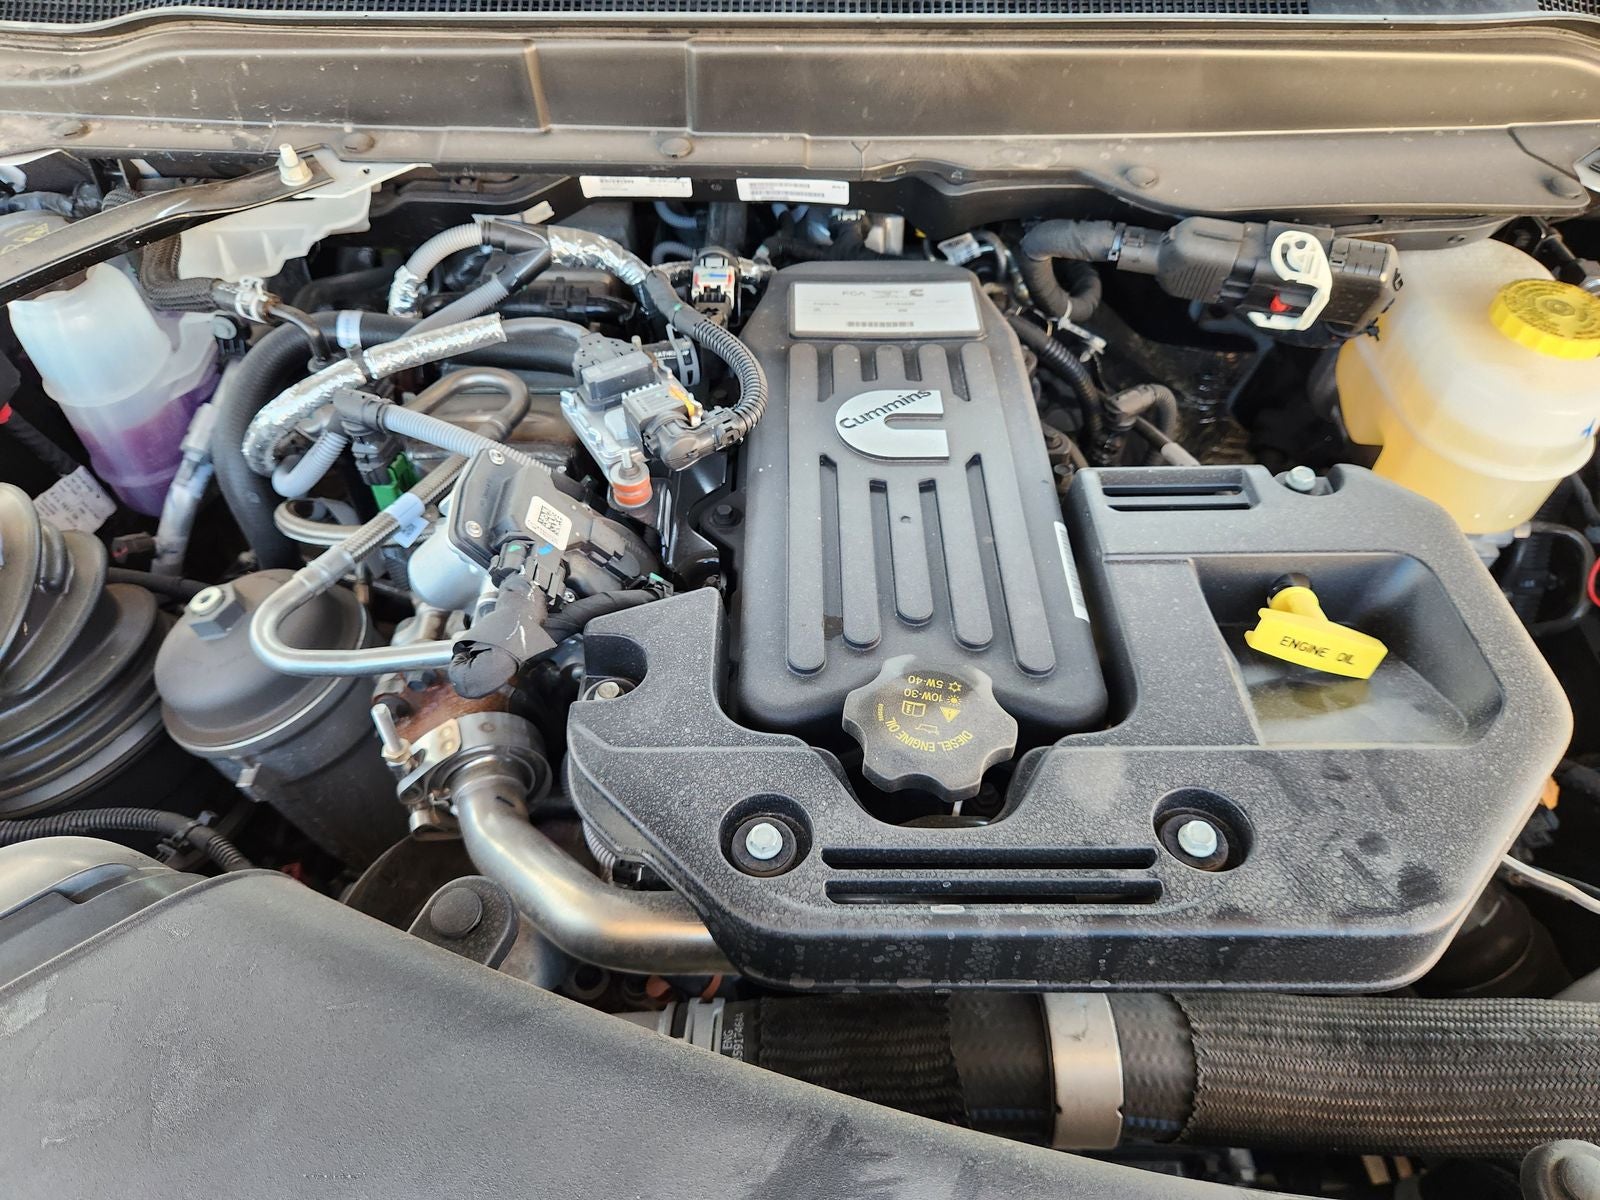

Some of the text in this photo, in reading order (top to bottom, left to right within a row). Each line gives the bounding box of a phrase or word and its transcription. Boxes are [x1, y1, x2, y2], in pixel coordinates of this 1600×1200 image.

[839, 390, 932, 429] Cummins
[1280, 635, 1356, 665] ENGINE OIL
[907, 675, 945, 689] 5W-40
[903, 688, 944, 702] 10W-30
[884, 716, 974, 752] DIESEL ENGINE OIL
[722, 1029, 733, 1050] ENG
